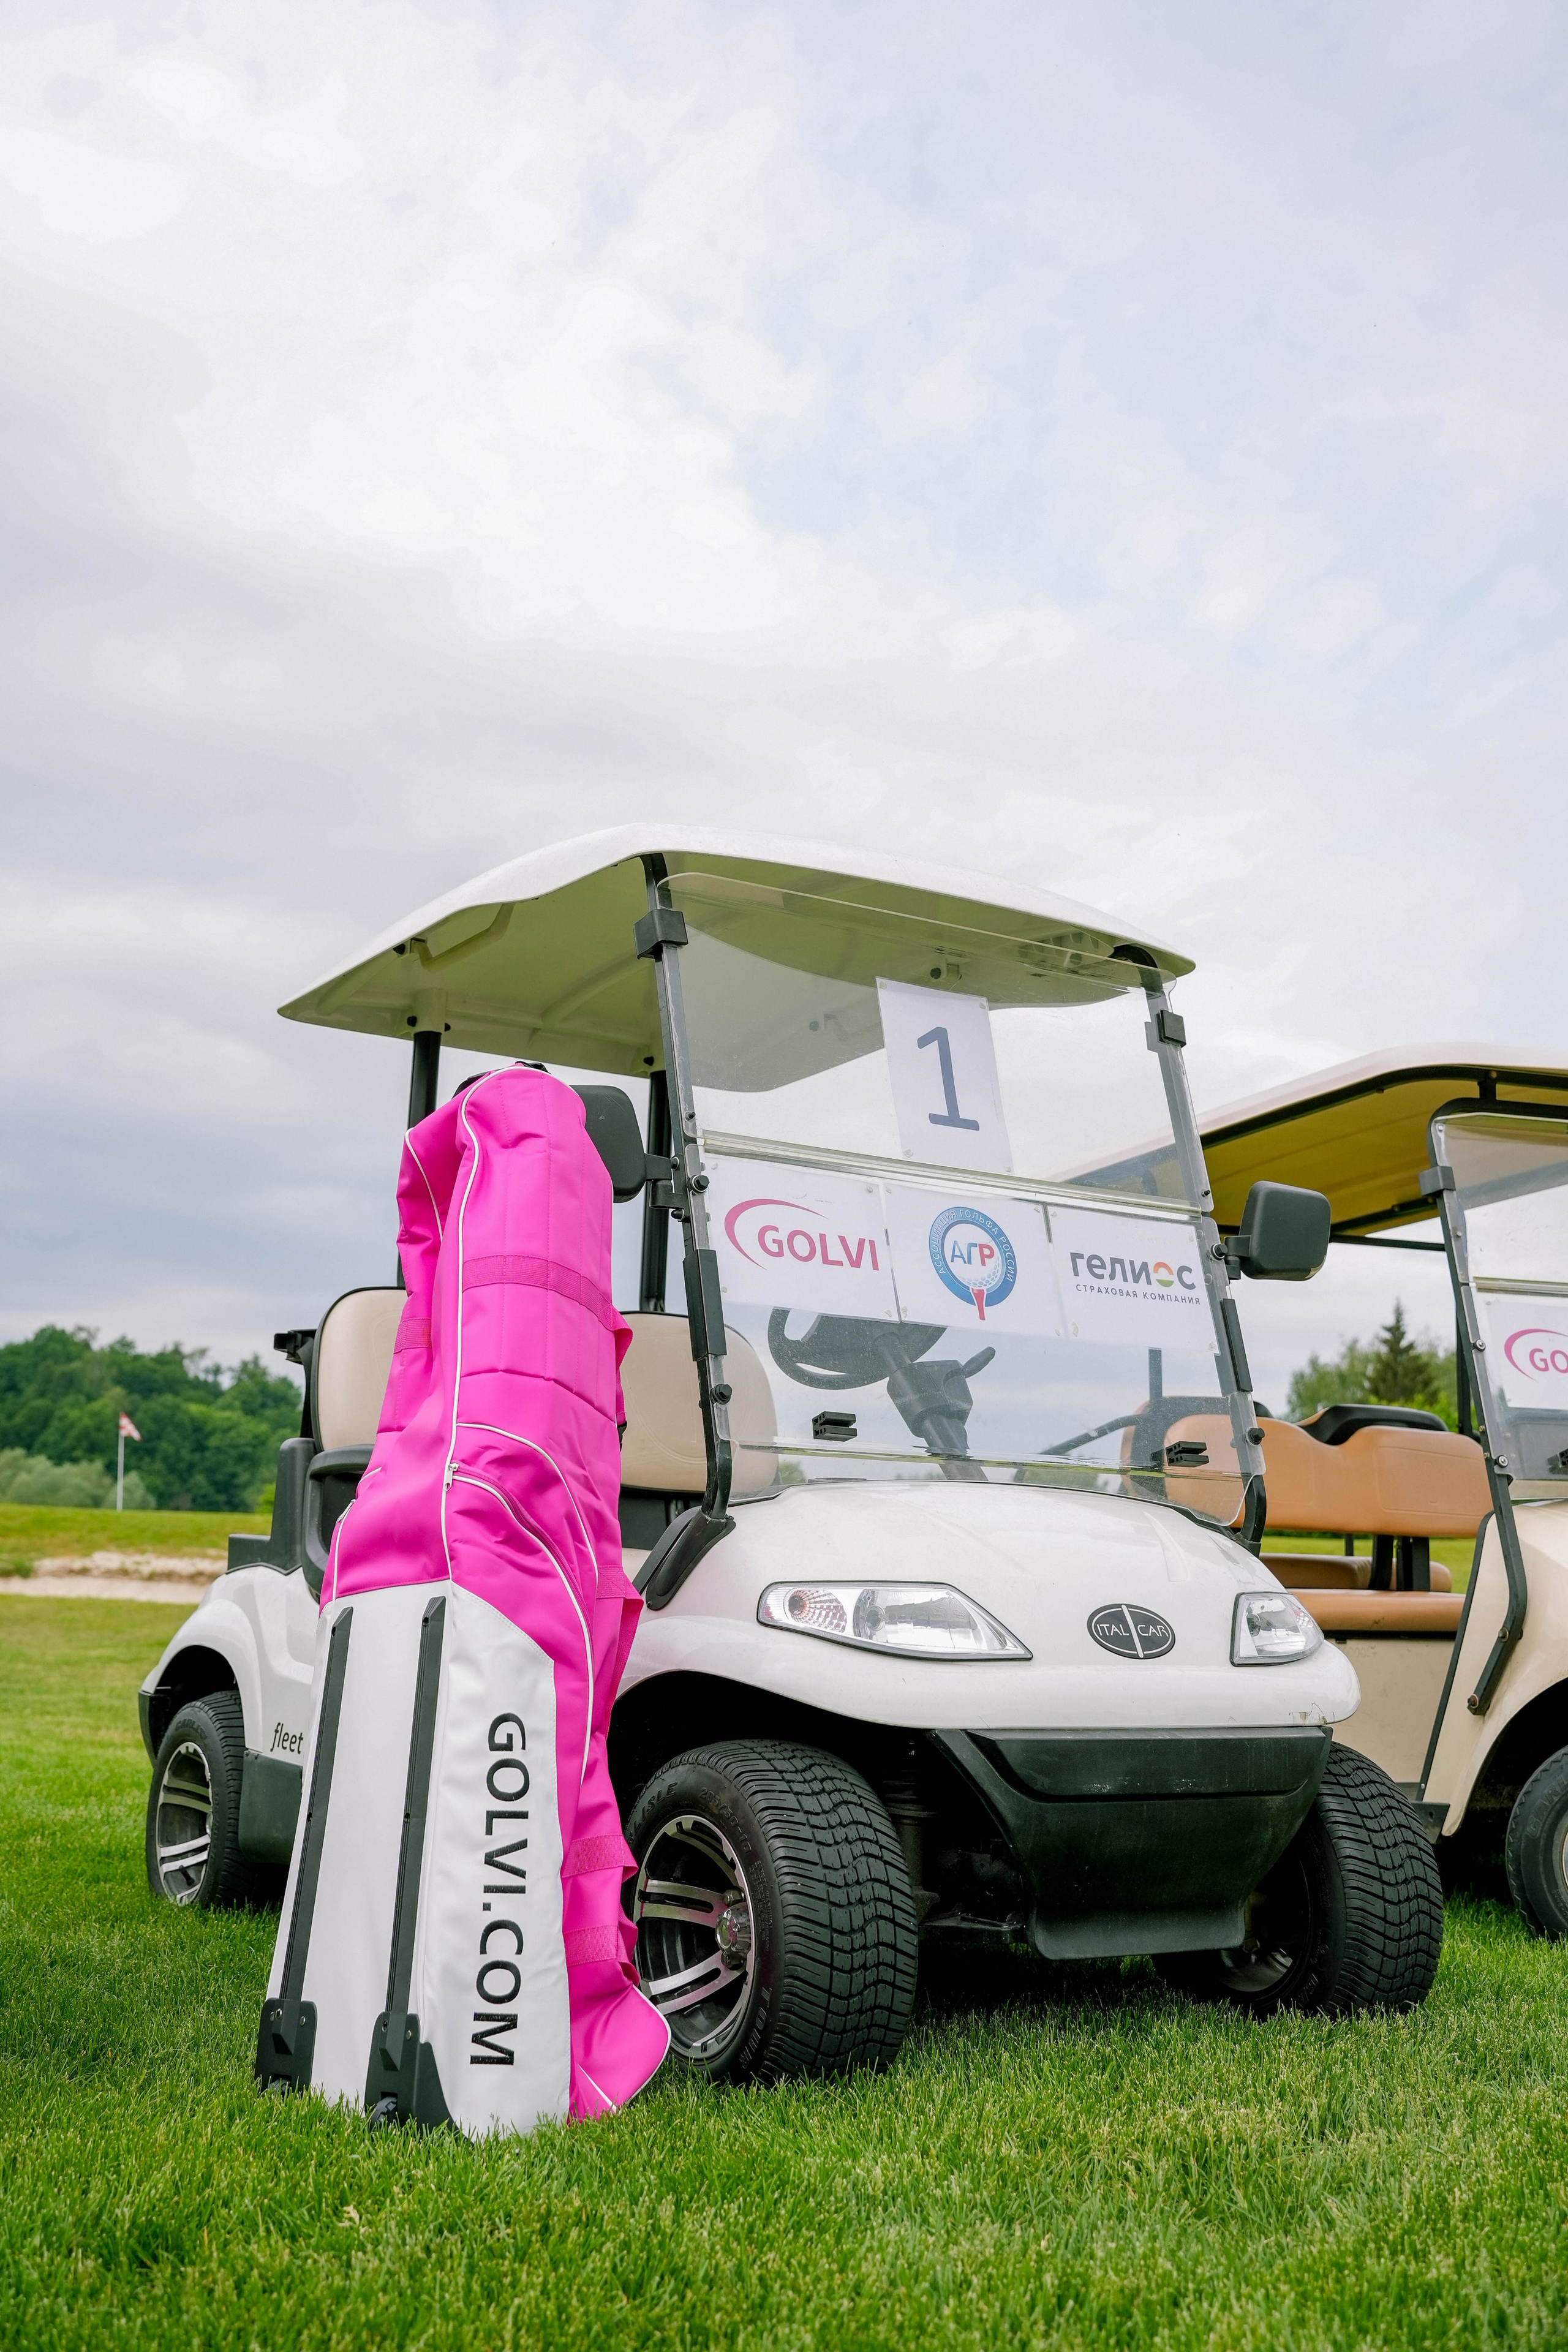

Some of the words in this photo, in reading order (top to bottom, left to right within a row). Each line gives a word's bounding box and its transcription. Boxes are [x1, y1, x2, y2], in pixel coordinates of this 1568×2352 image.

[917, 1026, 980, 1131] 1
[757, 1224, 880, 1271] GOLVI
[930, 1210, 957, 1274] АССОЦИАЦИЯ
[959, 1208, 998, 1235] ГОЛЬФА
[998, 1236, 1015, 1283] РОССИИ
[950, 1240, 995, 1267] АГР
[1076, 1284, 1138, 1298] СТРАХОВАЯ
[1142, 1291, 1200, 1305] КОМПАНИЯ
[1096, 1624, 1129, 1636] ITAL
[1137, 1624, 1169, 1637] CAR
[270, 1722, 304, 1755] fleet
[470, 1712, 530, 2066] GOLVI.COM
